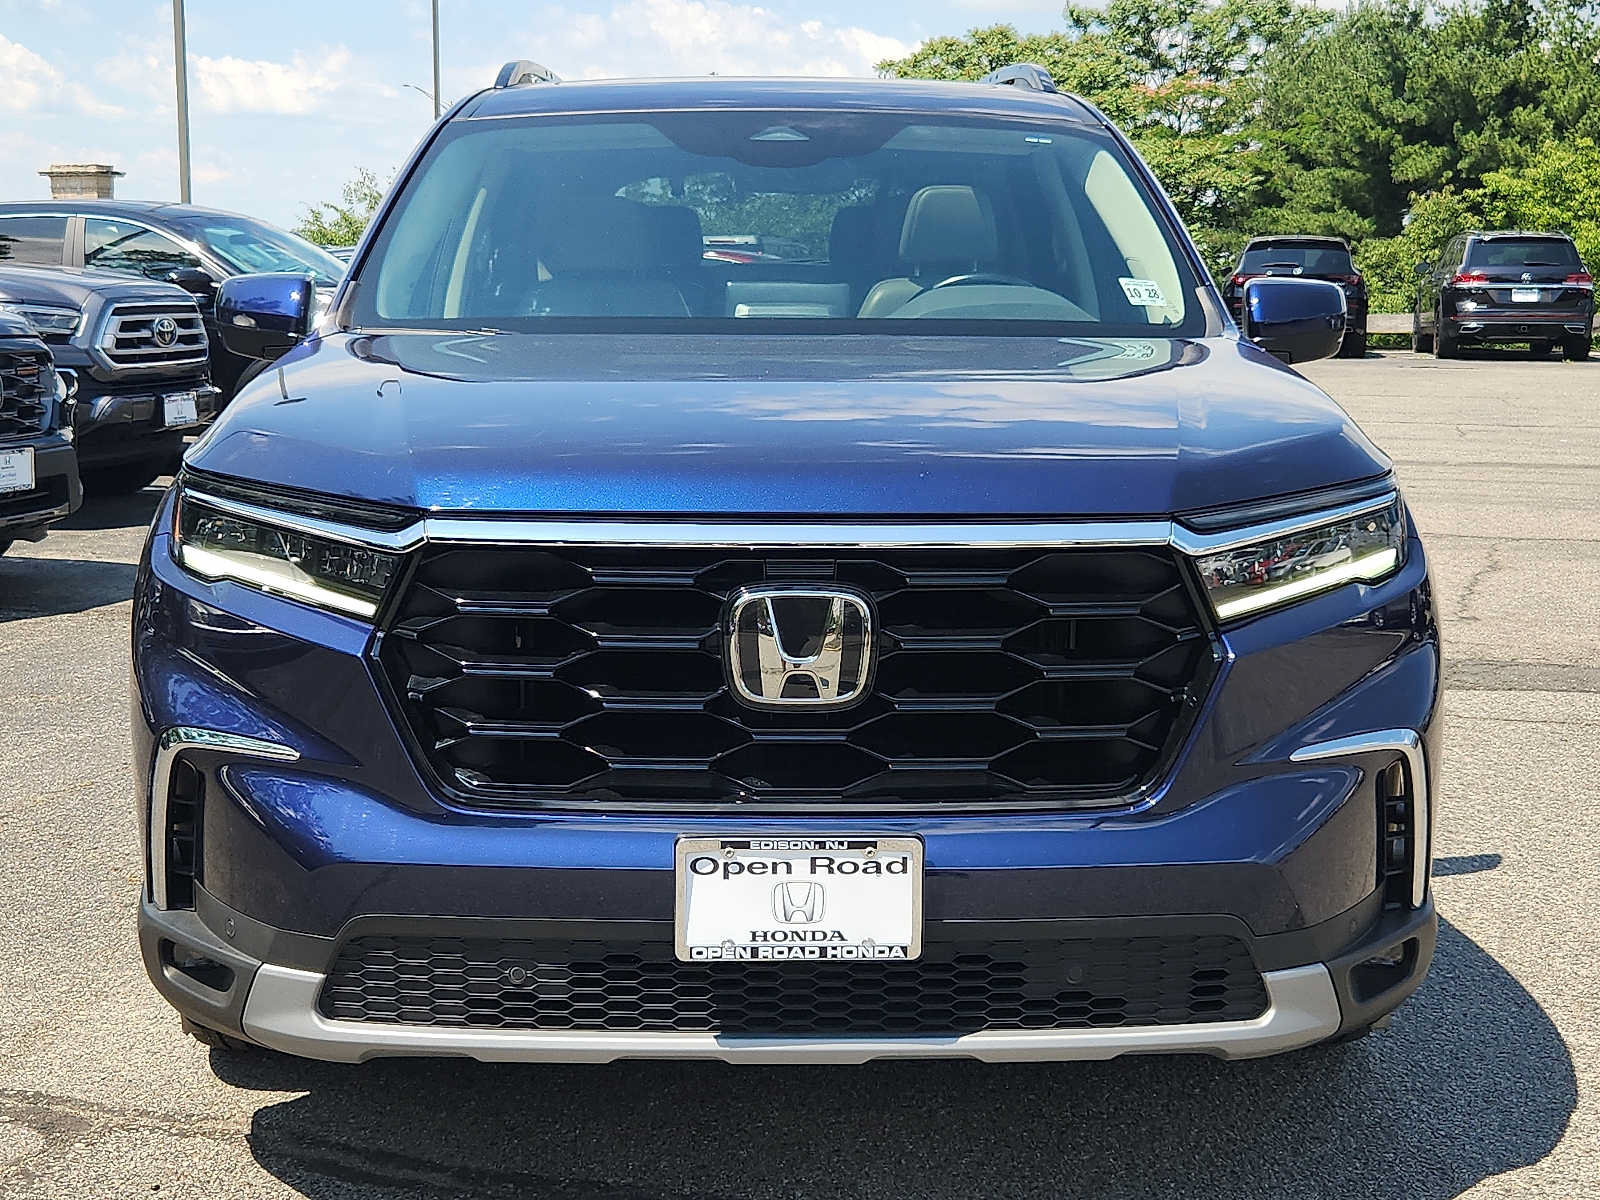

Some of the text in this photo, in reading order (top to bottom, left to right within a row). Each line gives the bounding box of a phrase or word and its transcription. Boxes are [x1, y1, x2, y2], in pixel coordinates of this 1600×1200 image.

[1127, 287, 1142, 298] 10
[825, 840, 848, 850] NJ
[689, 856, 908, 880] Open Road
[749, 930, 848, 942] HONDA
[691, 945, 905, 959] OPEN ROAD HONDA
